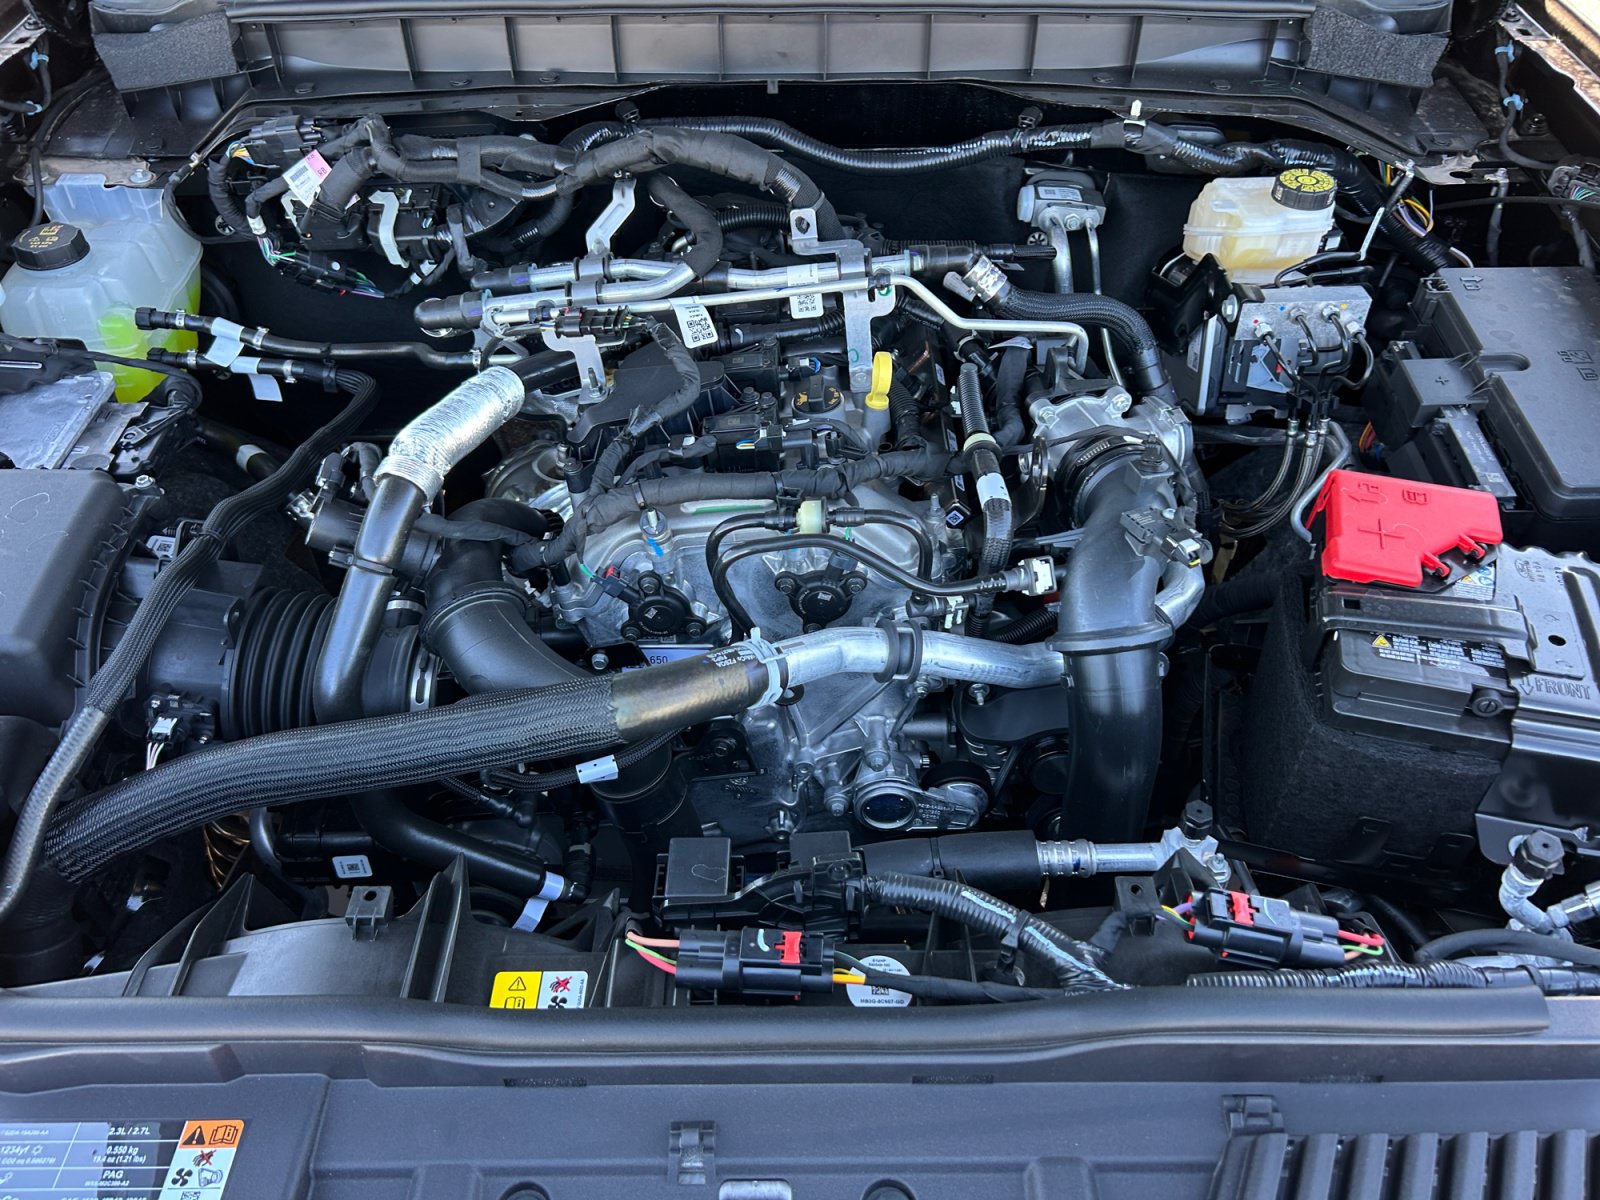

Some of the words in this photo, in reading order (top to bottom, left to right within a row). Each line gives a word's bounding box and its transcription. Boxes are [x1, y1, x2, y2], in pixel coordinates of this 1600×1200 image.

[1535, 677, 1590, 700] FRONT
[108, 1127, 126, 1135] 2.3L
[132, 1127, 150, 1135] 2.7L
[106, 1146, 127, 1155] 0.550
[128, 1145, 139, 1155] kg
[102, 1170, 124, 1179] PAG
